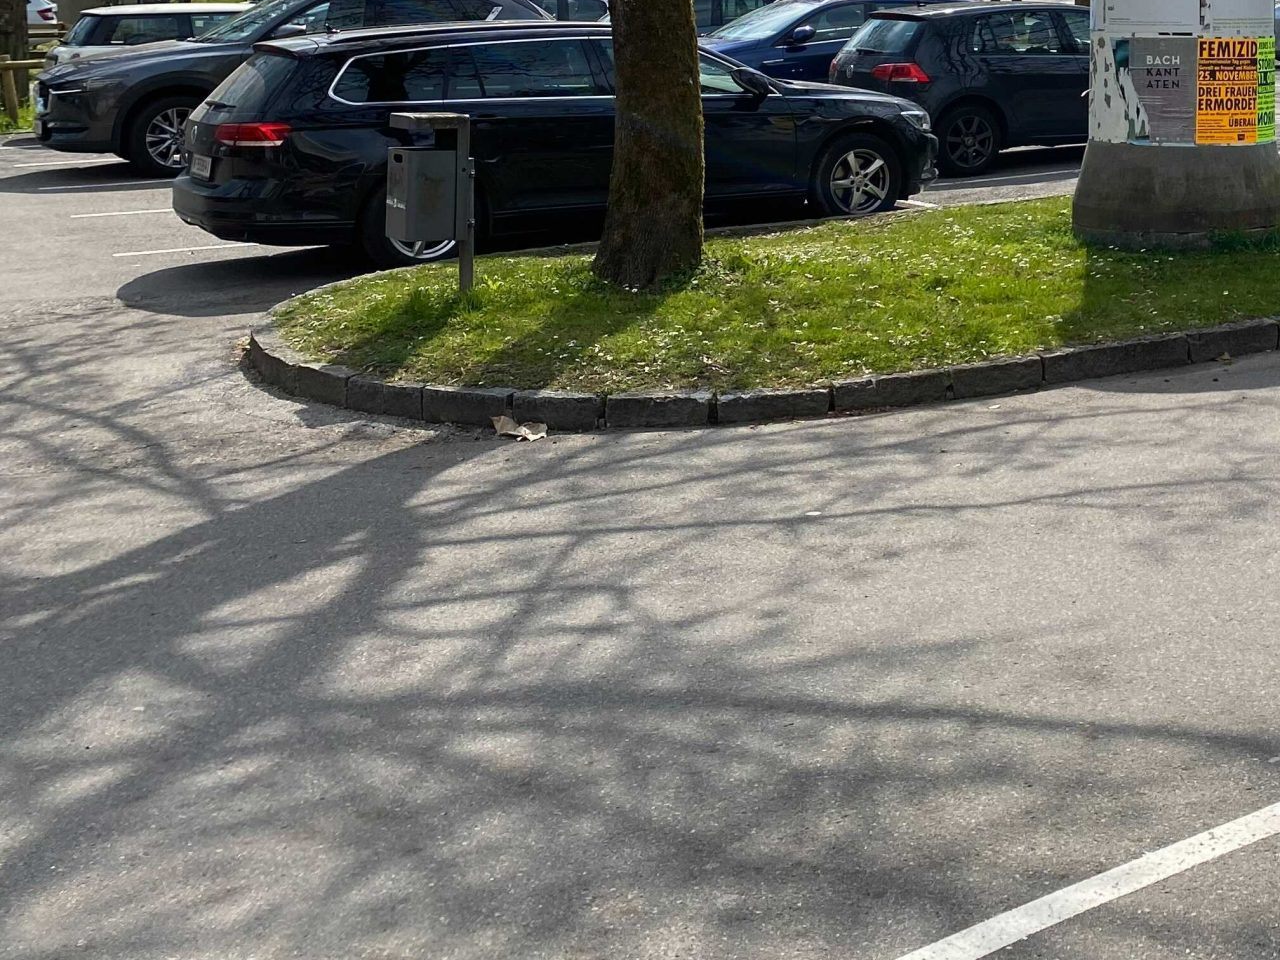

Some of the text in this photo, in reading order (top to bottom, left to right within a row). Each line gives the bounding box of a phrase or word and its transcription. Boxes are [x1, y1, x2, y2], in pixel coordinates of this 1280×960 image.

[1199, 40, 1258, 58] FEMIZID
[1146, 55, 1181, 65] BACH
[1146, 67, 1181, 77] KANT
[1198, 70, 1214, 81] 25.
[1215, 70, 1258, 81] NOVEMBER
[1146, 79, 1180, 89] ATEN
[1198, 86, 1222, 98] DREI
[1225, 86, 1257, 97] FRAUEN
[1198, 98, 1257, 111] ERMORDET
